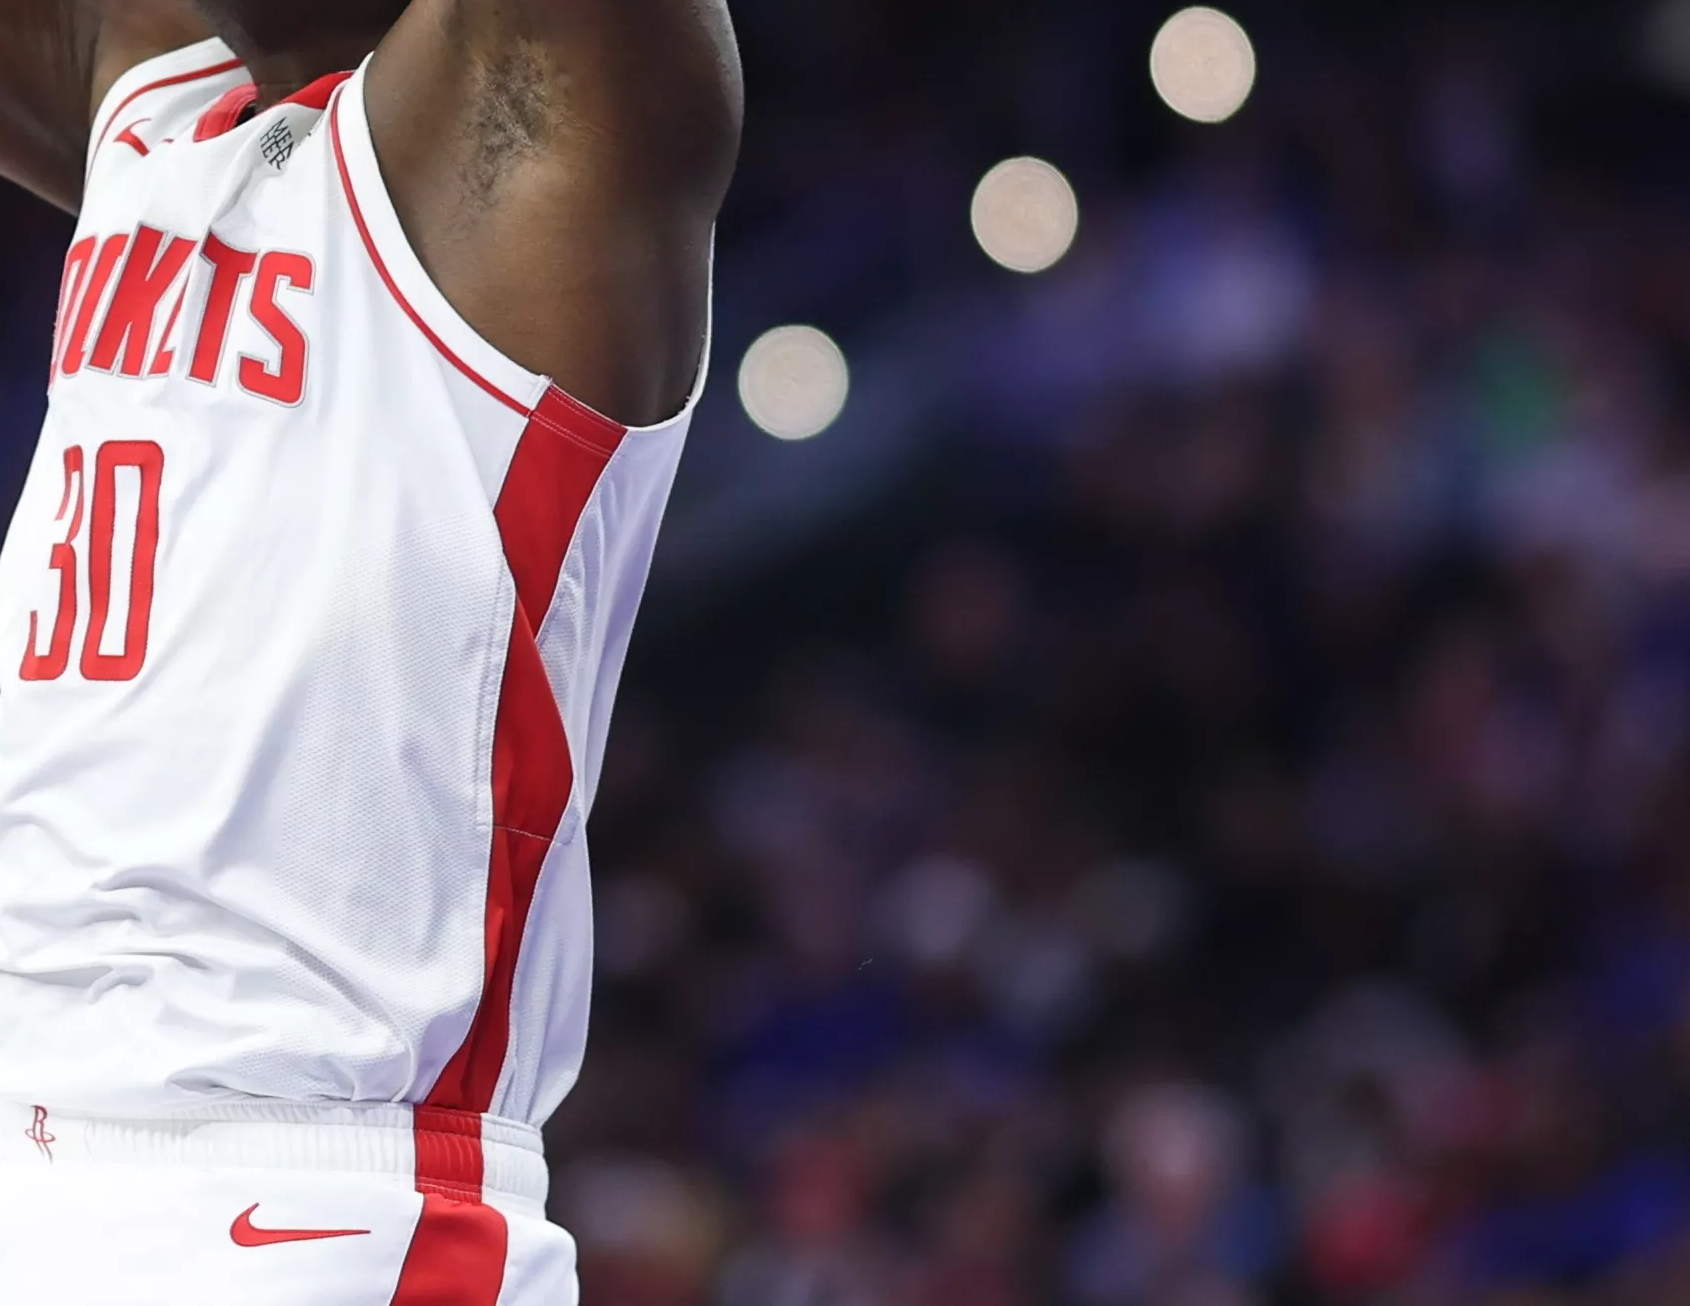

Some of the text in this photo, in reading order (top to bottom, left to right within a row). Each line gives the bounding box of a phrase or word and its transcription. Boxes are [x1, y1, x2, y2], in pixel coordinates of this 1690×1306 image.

[260, 128, 286, 170] HER
[49, 220, 317, 408] OCKTS
[19, 440, 164, 681] 30
